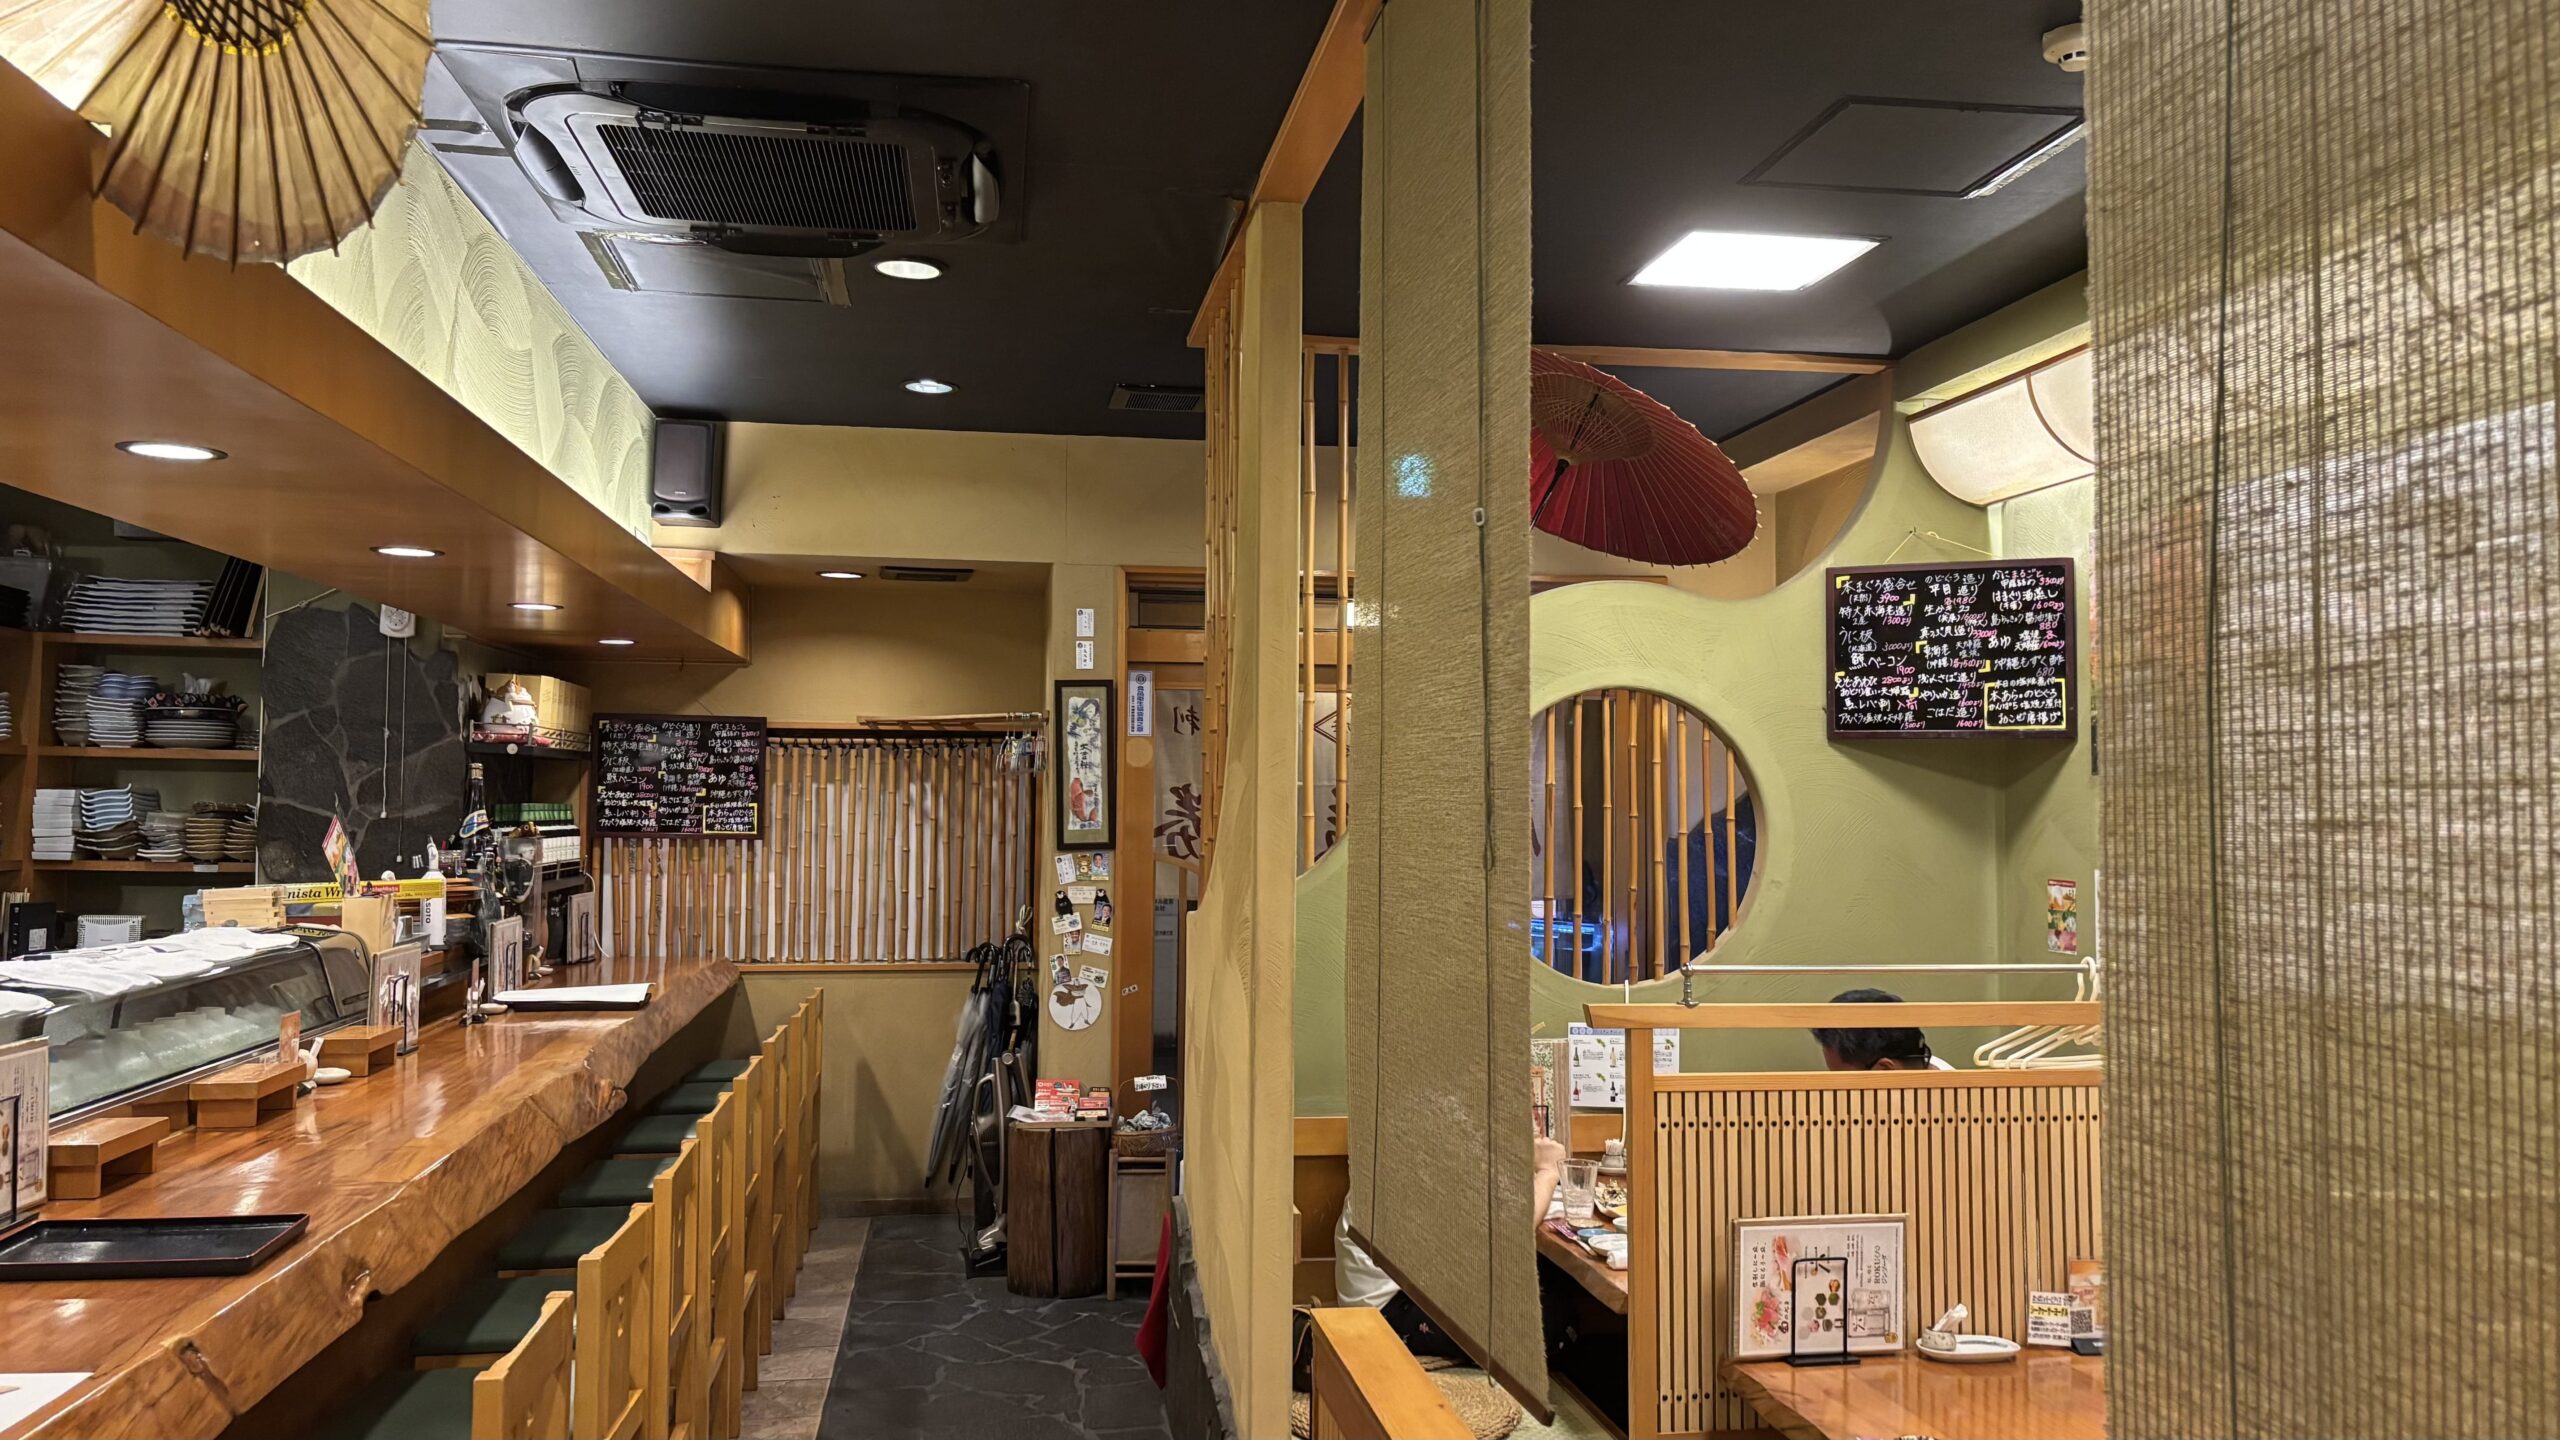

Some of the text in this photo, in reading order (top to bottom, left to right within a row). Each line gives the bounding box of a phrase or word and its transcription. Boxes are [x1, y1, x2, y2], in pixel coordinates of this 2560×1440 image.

[1877, 593, 1900, 603] 3900
[2039, 621, 2058, 630] 880
[1839, 626, 1877, 646] うに板
[1988, 635, 2011, 650] あゆ
[1897, 665, 1916, 675] 1900
[1926, 706, 1977, 719] こはだ造り
[639, 782, 654, 790] 1900
